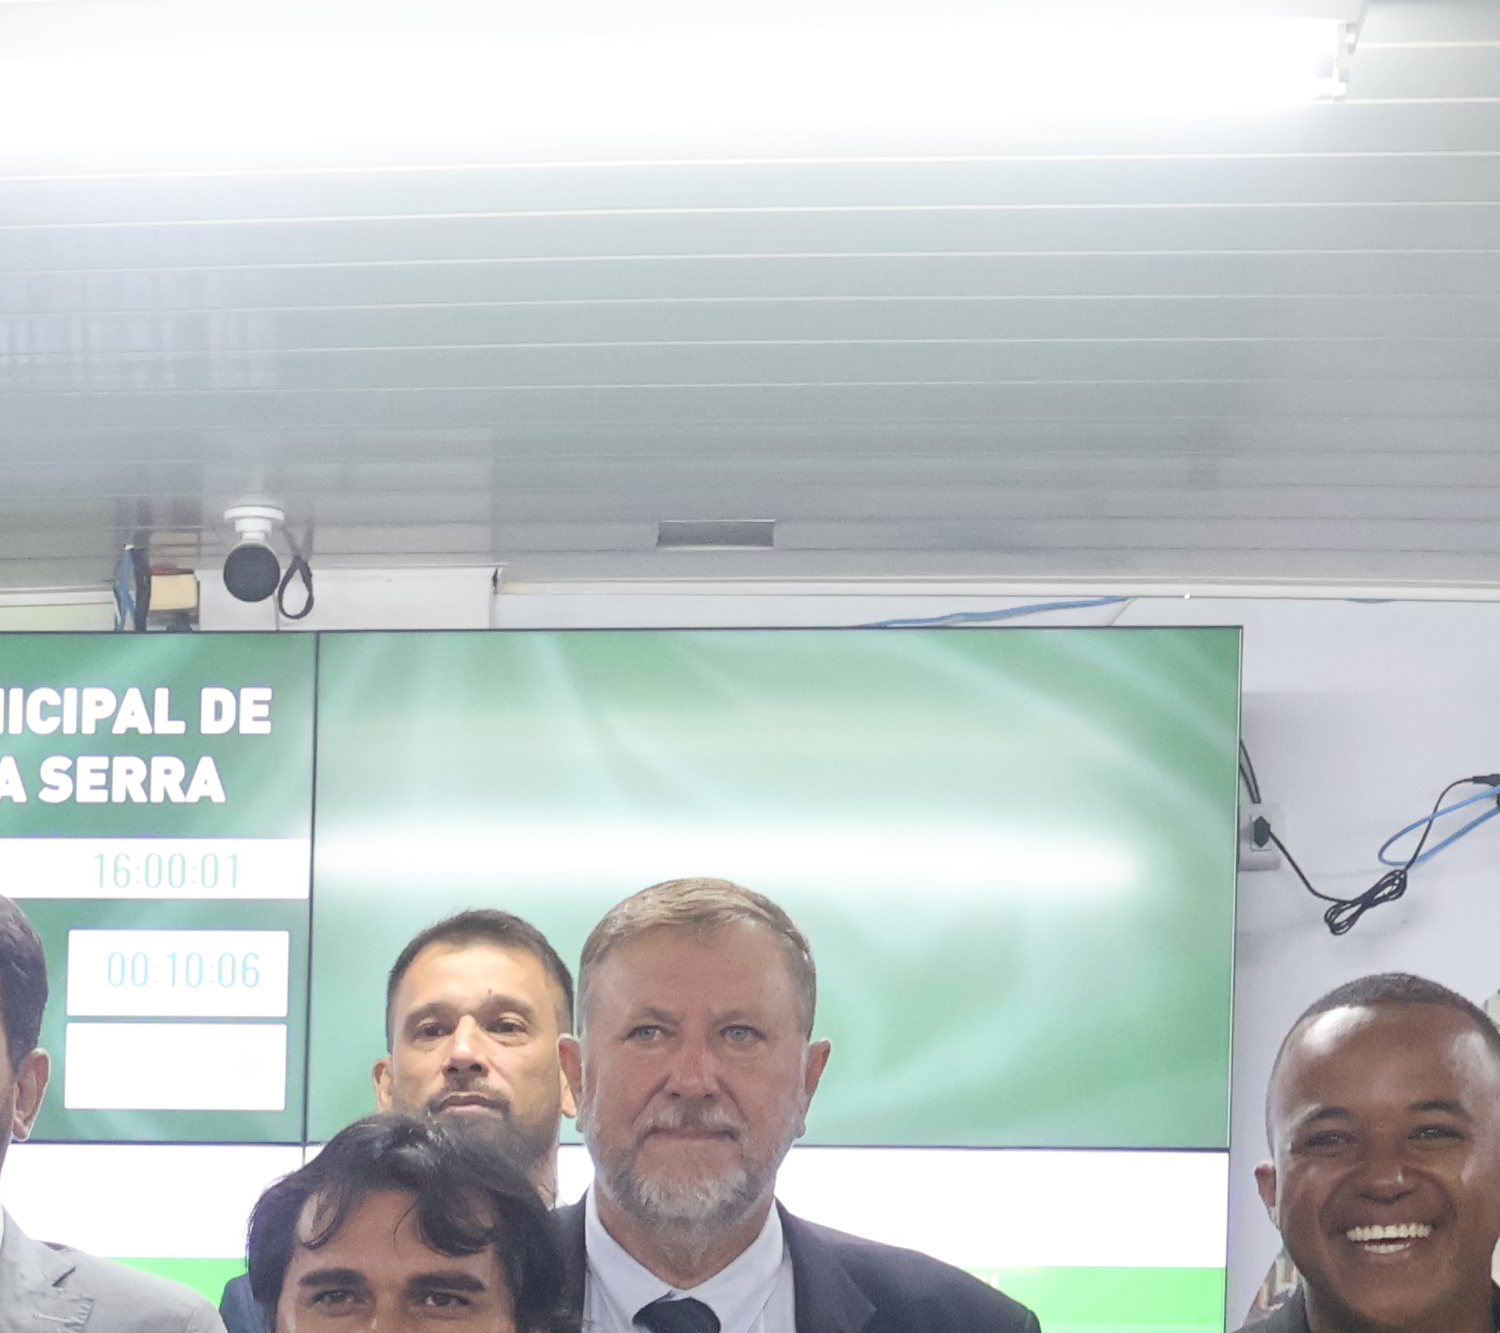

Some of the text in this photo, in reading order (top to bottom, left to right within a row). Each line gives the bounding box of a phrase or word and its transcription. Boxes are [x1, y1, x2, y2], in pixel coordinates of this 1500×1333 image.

[201, 688, 272, 734] DE
[39, 755, 226, 803] SERRA
[94, 853, 240, 889] 16:00:01
[106, 951, 261, 989] 00:10:06
